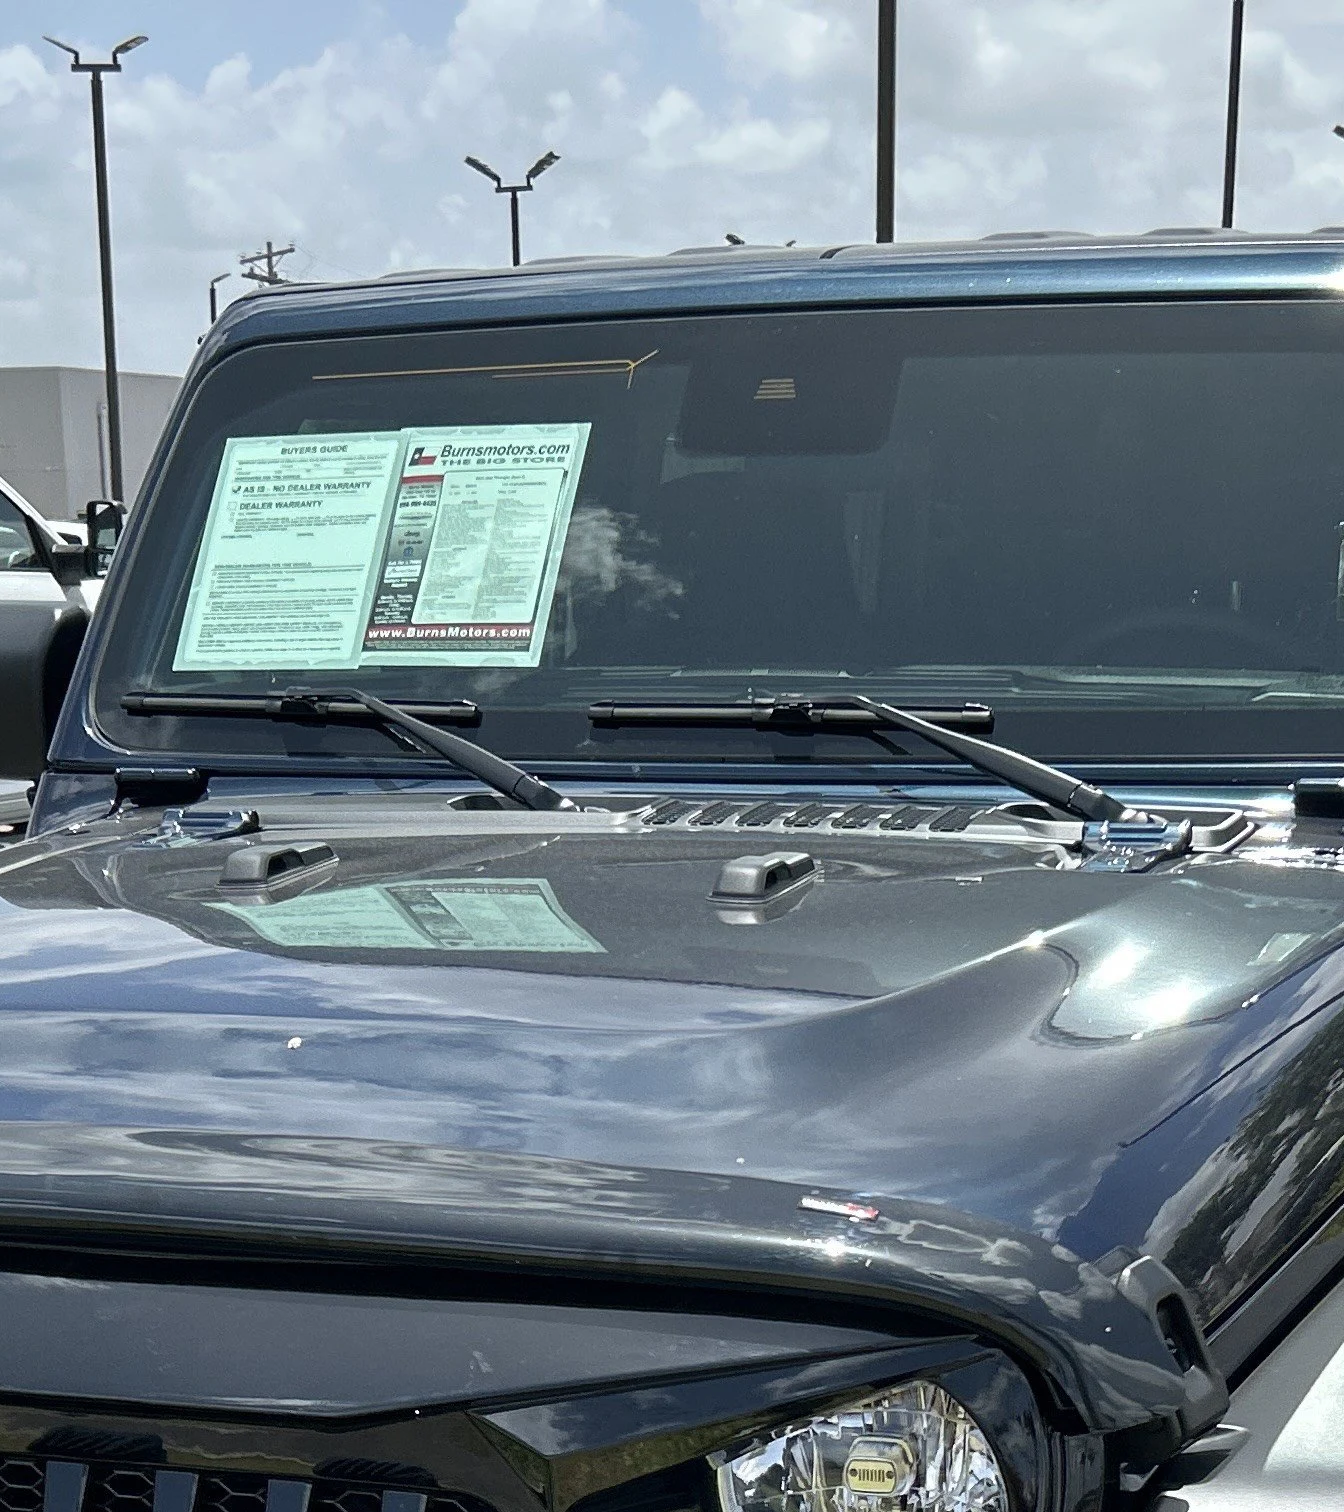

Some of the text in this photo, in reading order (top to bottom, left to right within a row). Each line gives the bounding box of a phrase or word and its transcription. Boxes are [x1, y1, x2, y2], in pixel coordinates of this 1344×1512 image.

[281, 444, 348, 455] BUYERS GUIDE
[441, 444, 570, 457] Burnsmotors.com
[441, 456, 566, 466] THE BIG STORE
[240, 502, 273, 510] DEALER
[368, 627, 531, 639] www.BurnsMotors.com
